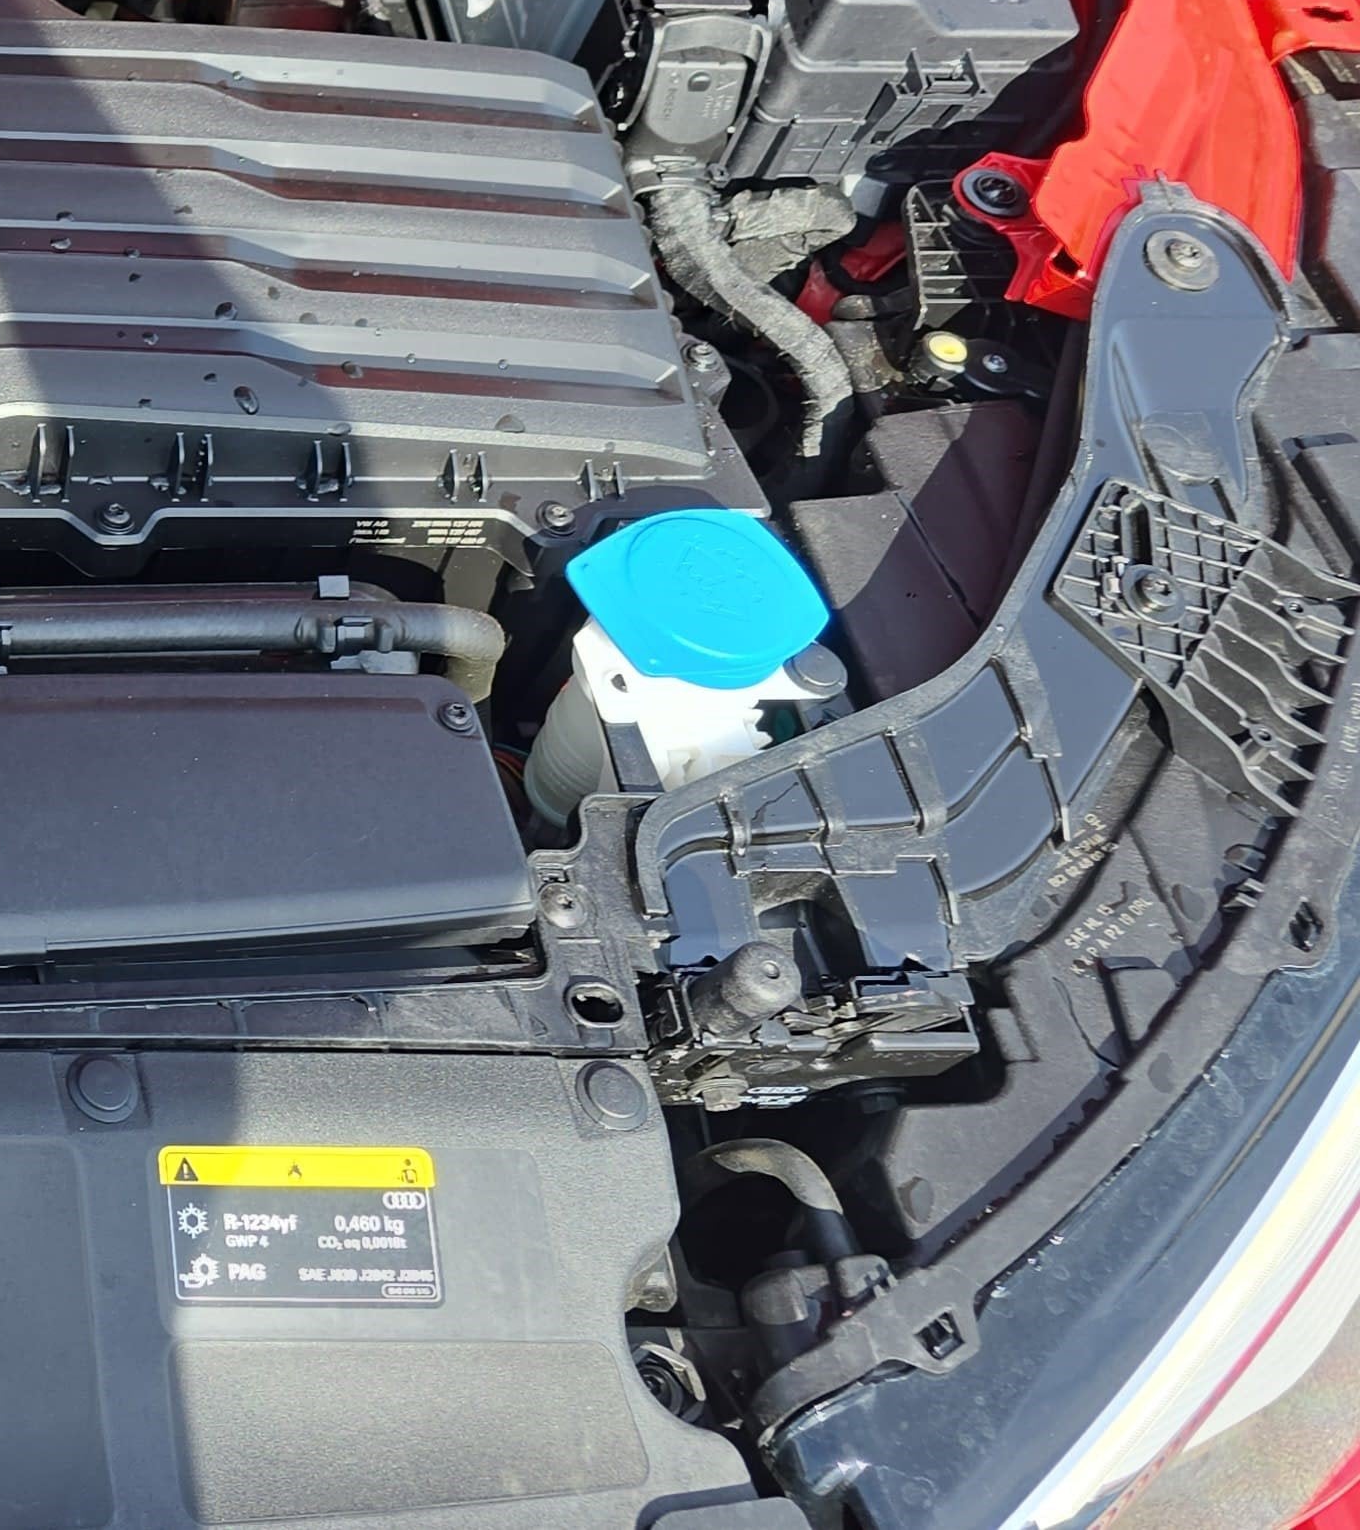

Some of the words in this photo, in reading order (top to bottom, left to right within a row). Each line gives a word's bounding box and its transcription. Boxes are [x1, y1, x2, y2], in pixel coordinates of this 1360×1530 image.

[1064, 927, 1091, 950] SAE
[224, 1213, 299, 1234] R-1234yf
[334, 1215, 381, 1233] 0,460
[383, 1215, 405, 1235] kg
[225, 1235, 258, 1248] GWP
[259, 1235, 269, 1248] 4
[228, 1263, 267, 1281] PAG
[298, 1267, 327, 1281] SAE
